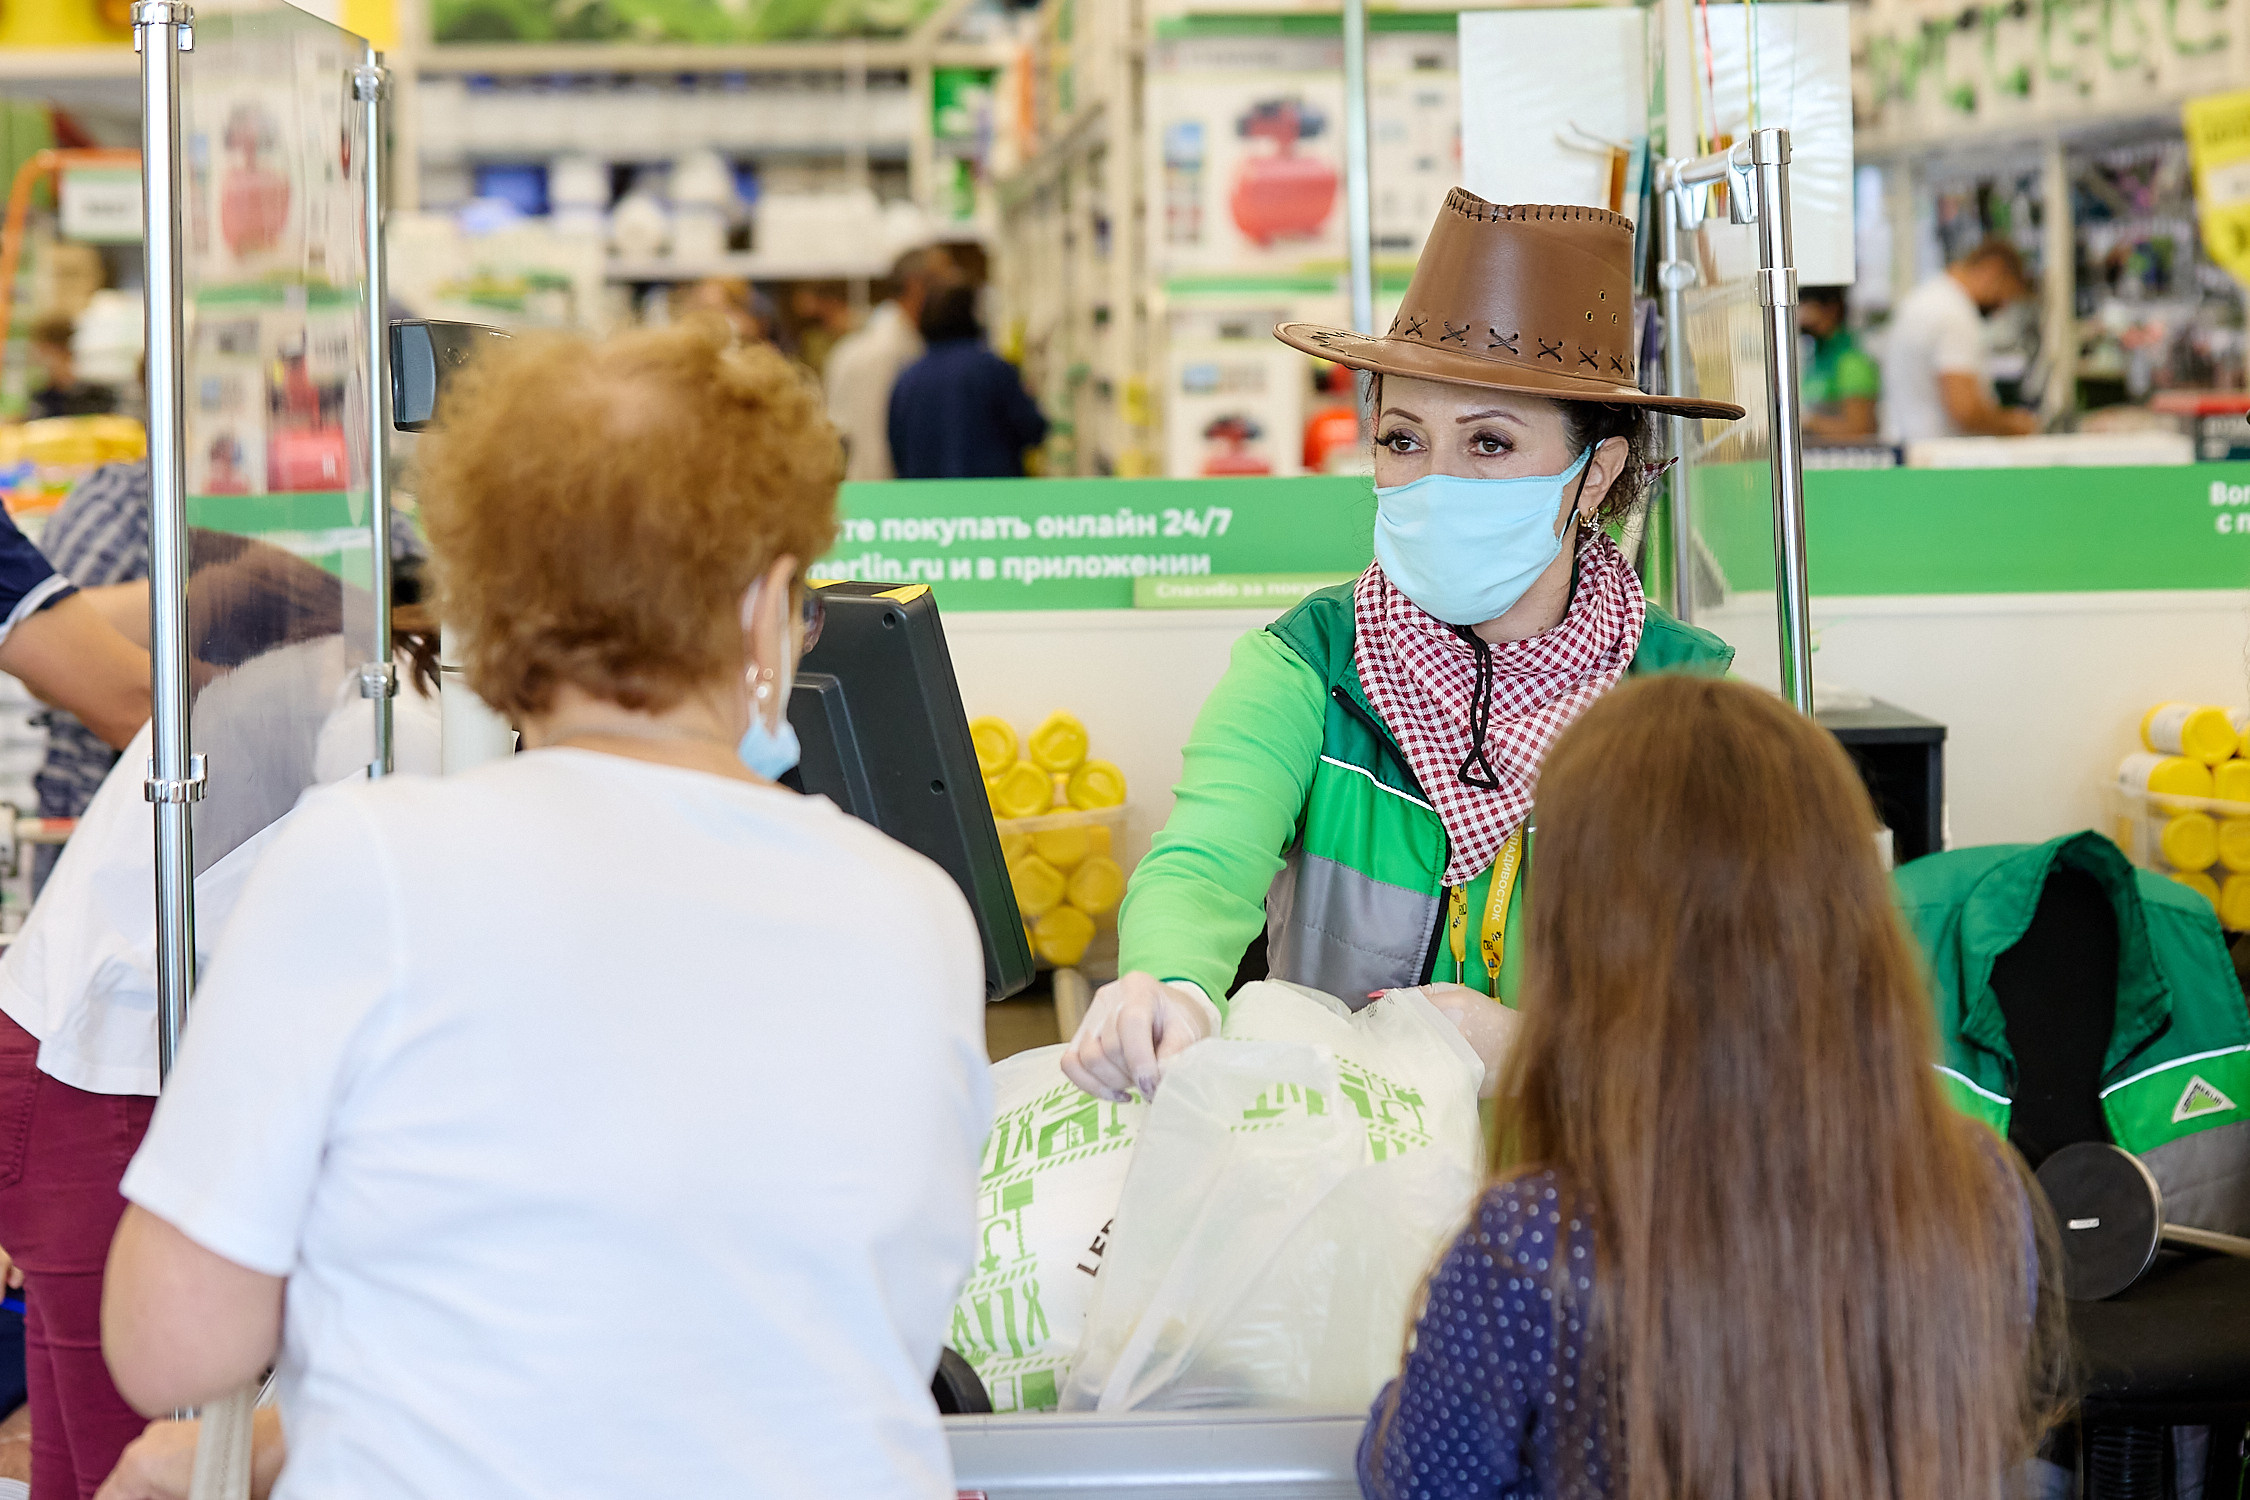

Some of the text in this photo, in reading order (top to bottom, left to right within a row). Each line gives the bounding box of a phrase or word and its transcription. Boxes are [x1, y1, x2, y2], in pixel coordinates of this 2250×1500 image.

[837, 506, 1233, 547] те покупать онлайн 24/7
[949, 557, 973, 580] и
[976, 557, 997, 580] в
[1001, 553, 1212, 585] приложении
[1491, 828, 1522, 922] ВЛАДИВОСТОК
